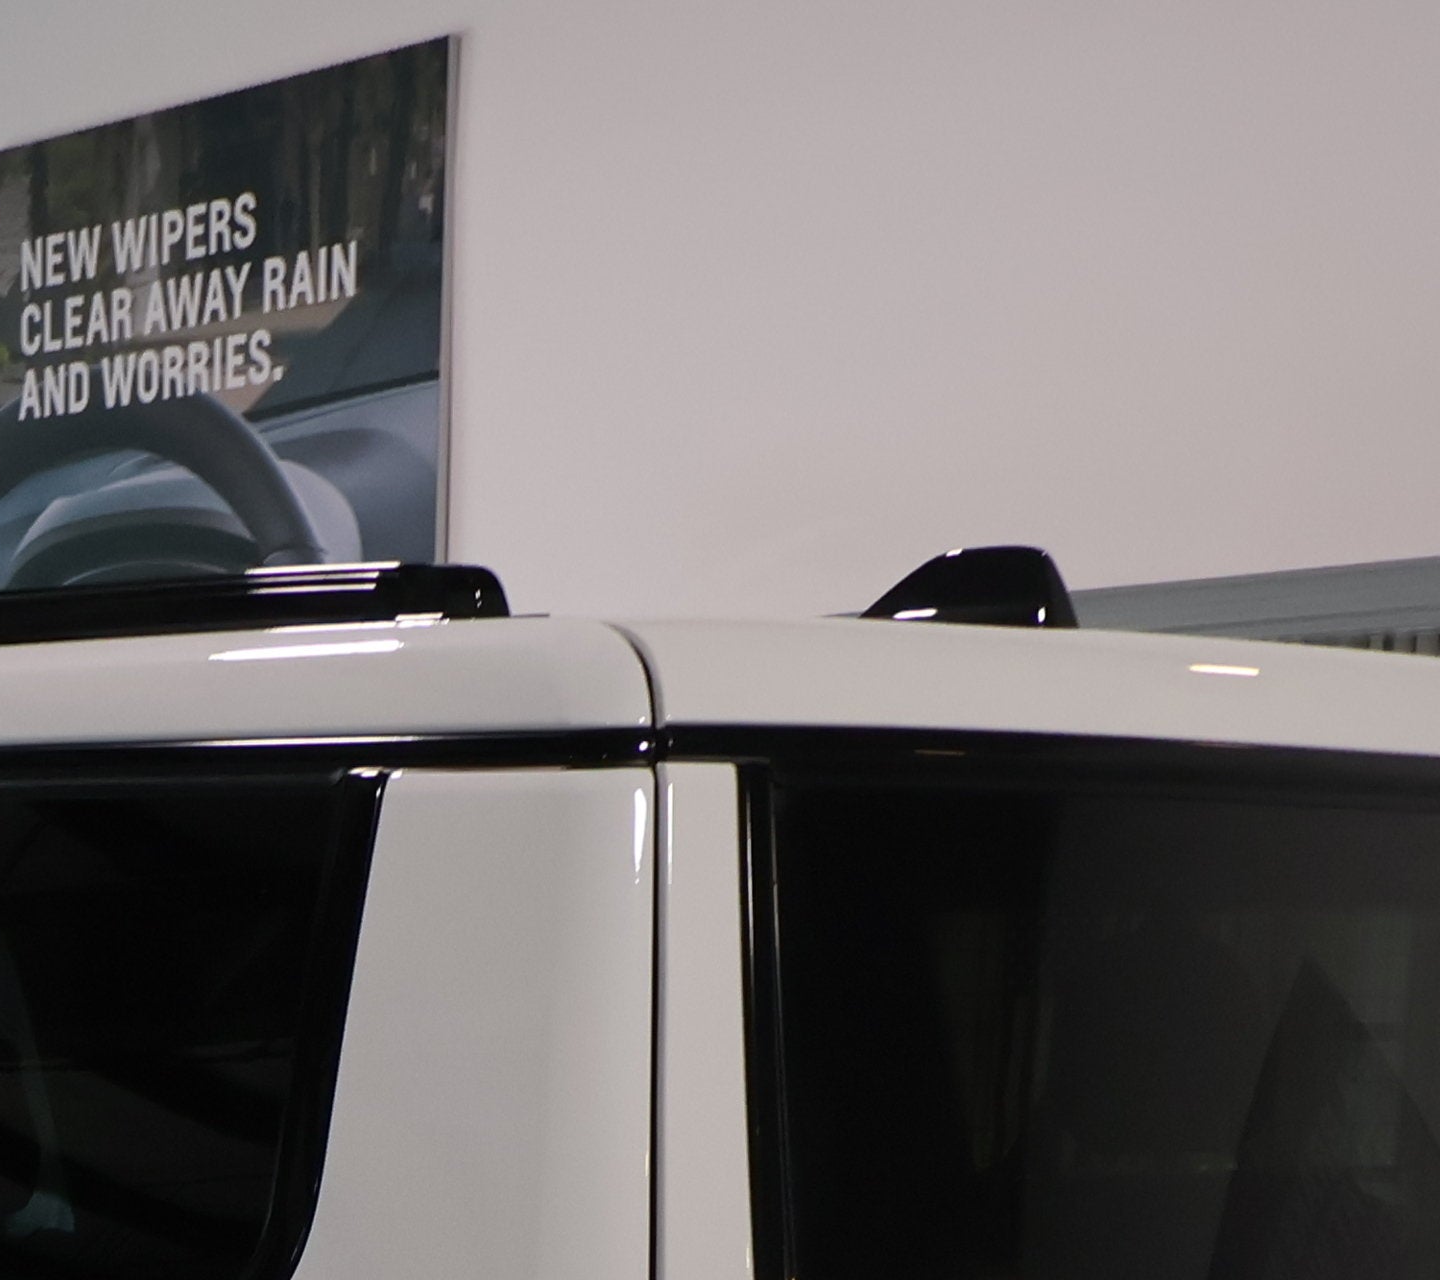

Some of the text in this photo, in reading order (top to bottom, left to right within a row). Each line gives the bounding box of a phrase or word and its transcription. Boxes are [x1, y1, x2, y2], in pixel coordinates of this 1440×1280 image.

[21, 191, 258, 292] NEW WIPERS
[21, 240, 358, 357] CLEAR AWAY RAIN
[18, 328, 285, 422] AND WORRIES.
